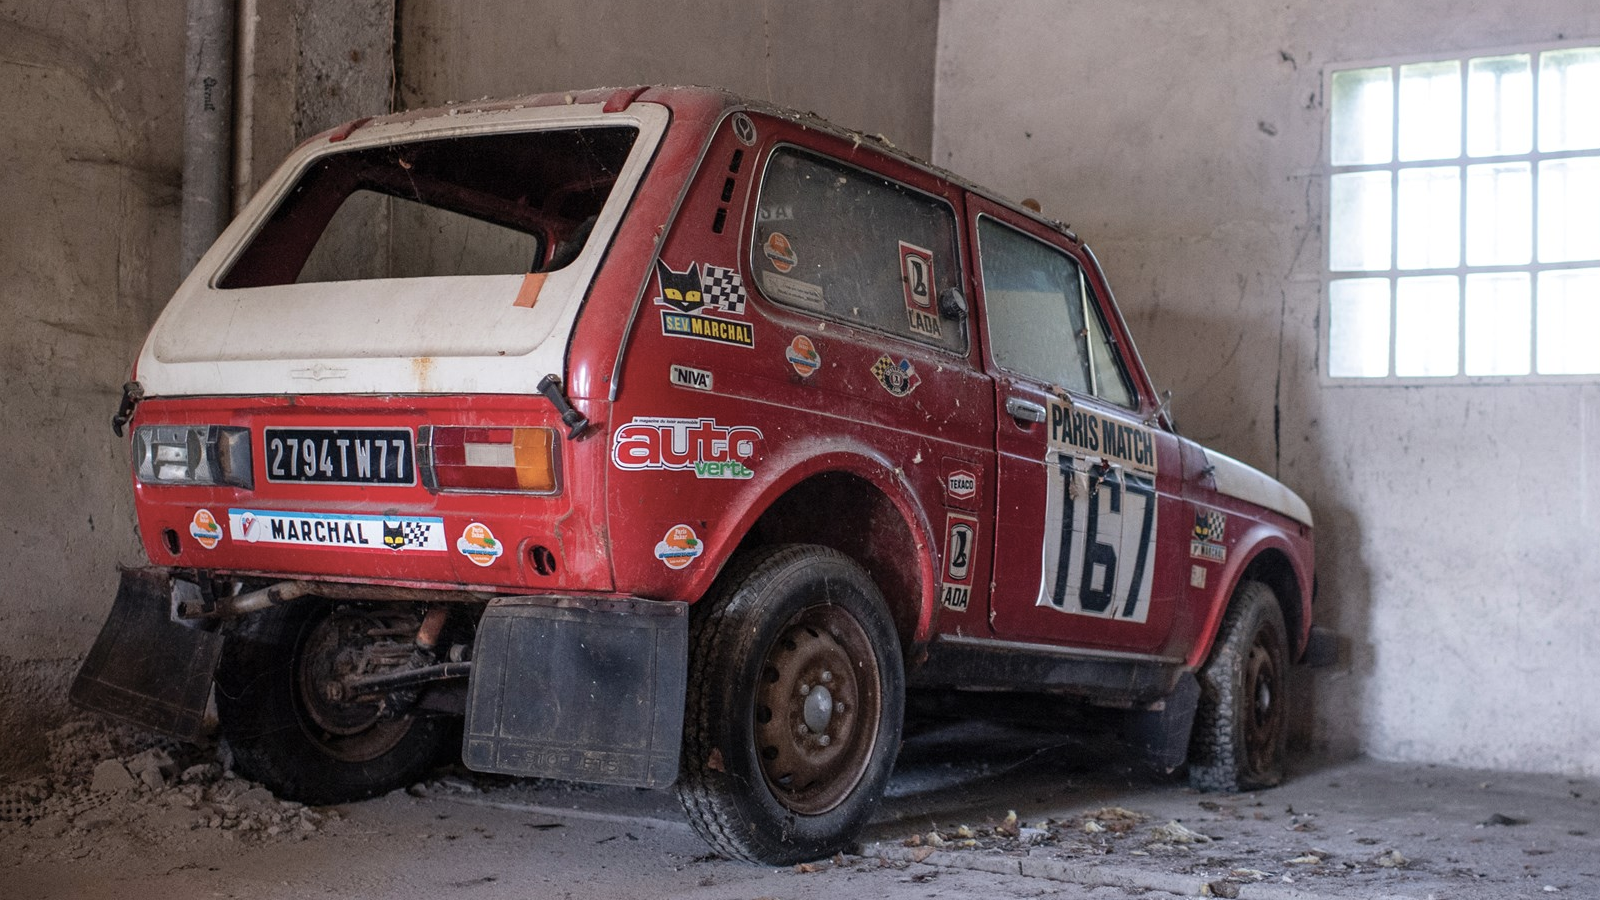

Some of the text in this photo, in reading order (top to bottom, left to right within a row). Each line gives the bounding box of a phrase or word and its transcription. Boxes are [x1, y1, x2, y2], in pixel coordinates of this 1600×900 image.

[691, 317, 751, 343] MARCHAL
[908, 308, 942, 336] LADA
[674, 367, 710, 388] "NIVA"
[614, 419, 762, 468] auto
[1052, 403, 1154, 467] PARIS MATCH
[695, 460, 752, 477] verte
[950, 479, 974, 490] TEXACO
[270, 518, 370, 545] MARCHAL
[1053, 454, 1156, 618] 167
[943, 586, 969, 608] ADA
